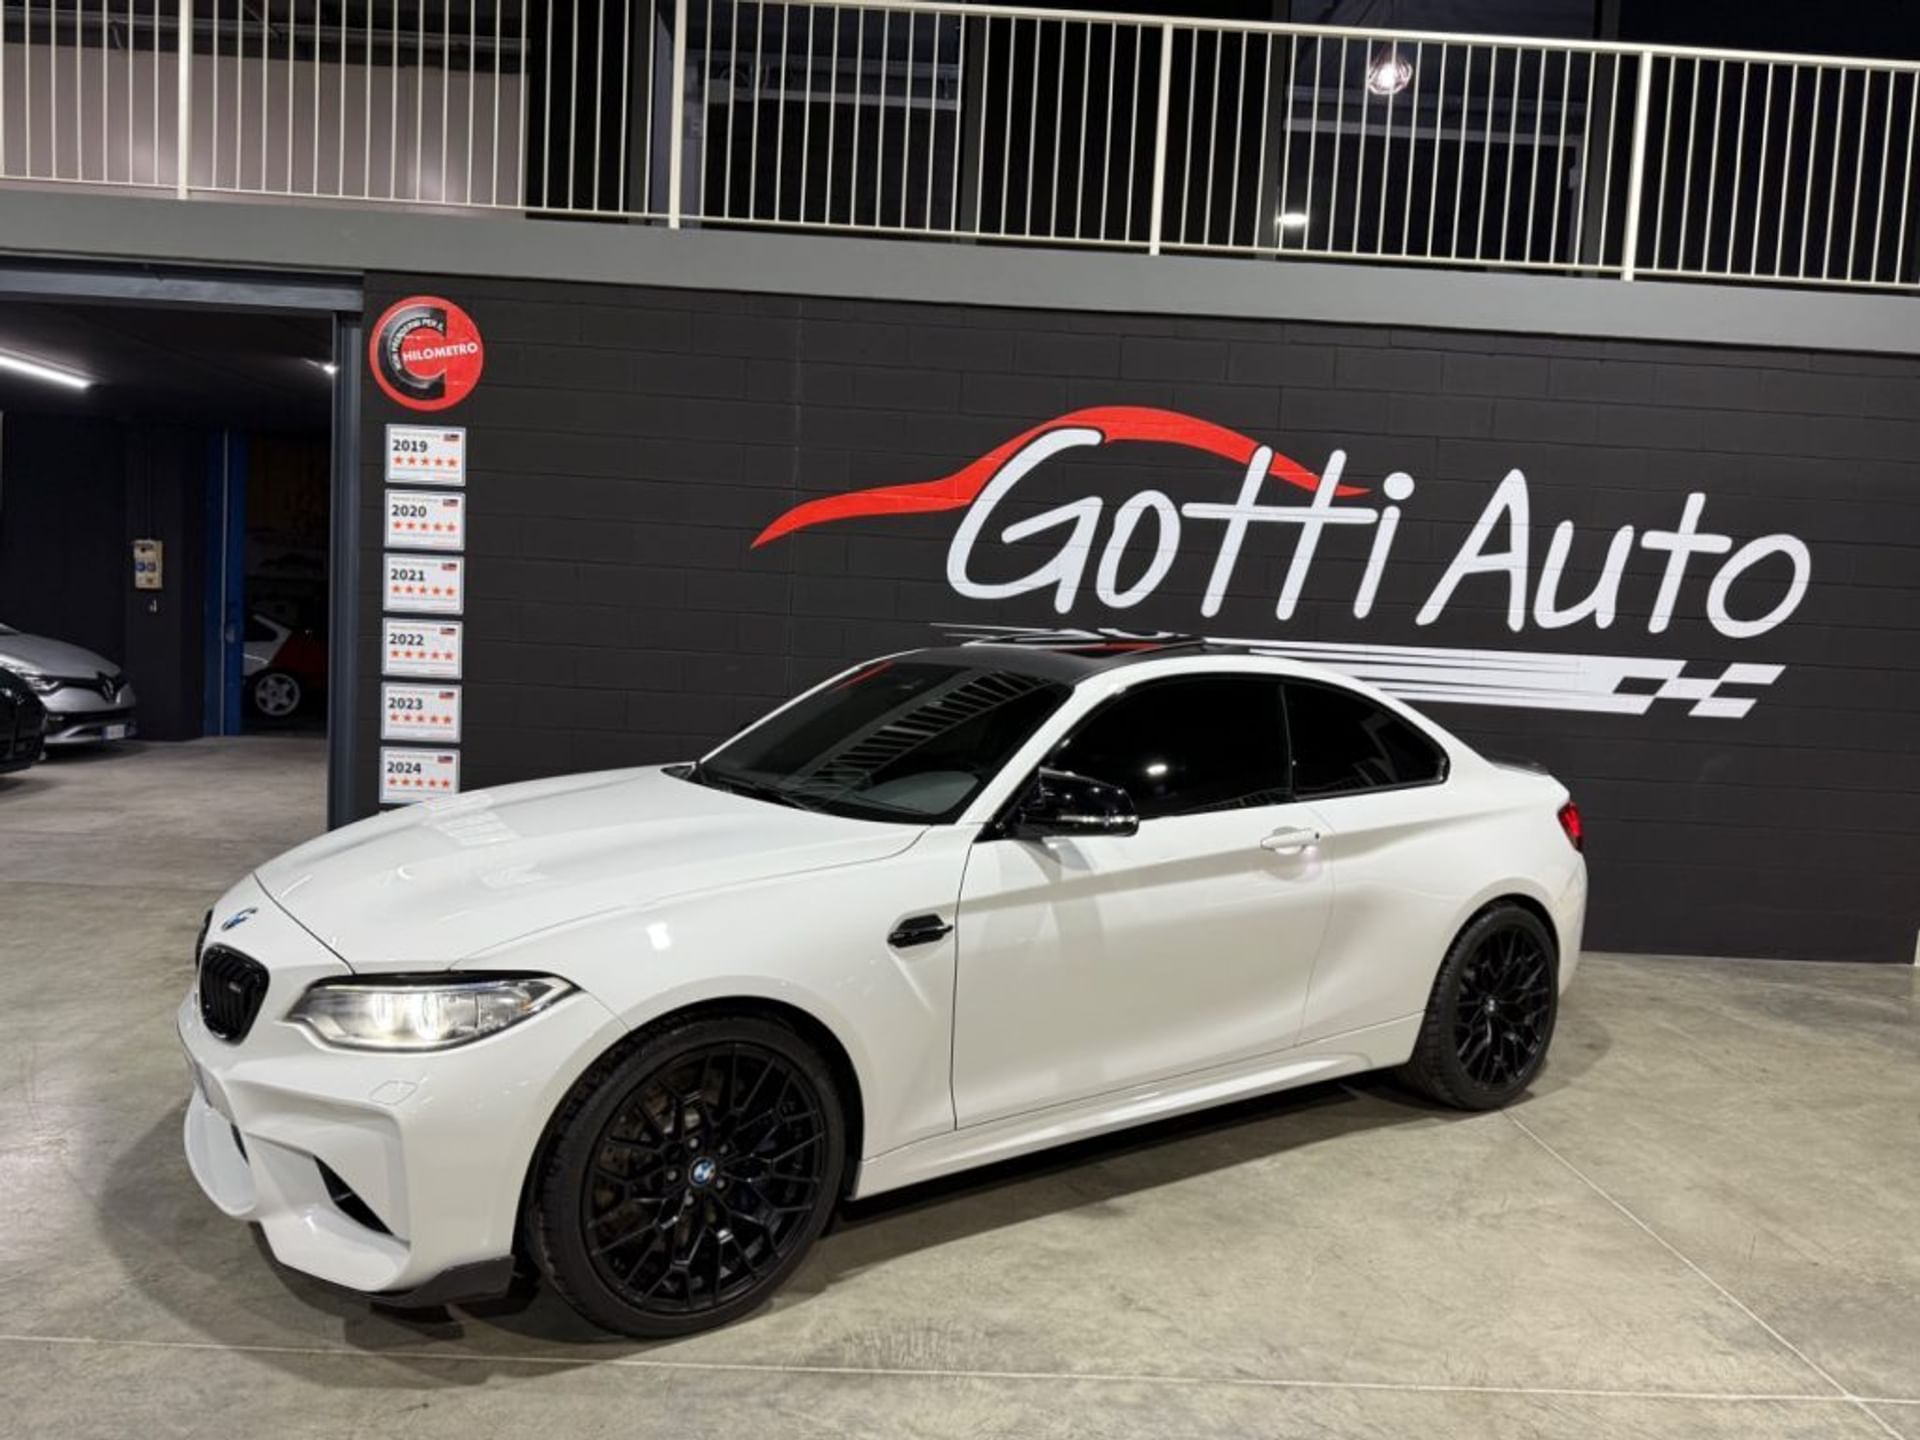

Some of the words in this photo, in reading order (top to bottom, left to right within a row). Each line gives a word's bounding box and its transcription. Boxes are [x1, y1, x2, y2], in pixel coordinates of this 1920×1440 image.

[392, 439, 428, 453] 2019
[391, 504, 427, 518] 2020
[946, 428, 1415, 619] Gotti
[1415, 467, 1812, 638] Auto
[390, 568, 426, 582] 2021
[389, 633, 424, 646] 2022
[388, 697, 423, 710] 2023
[387, 761, 422, 775] 2024
